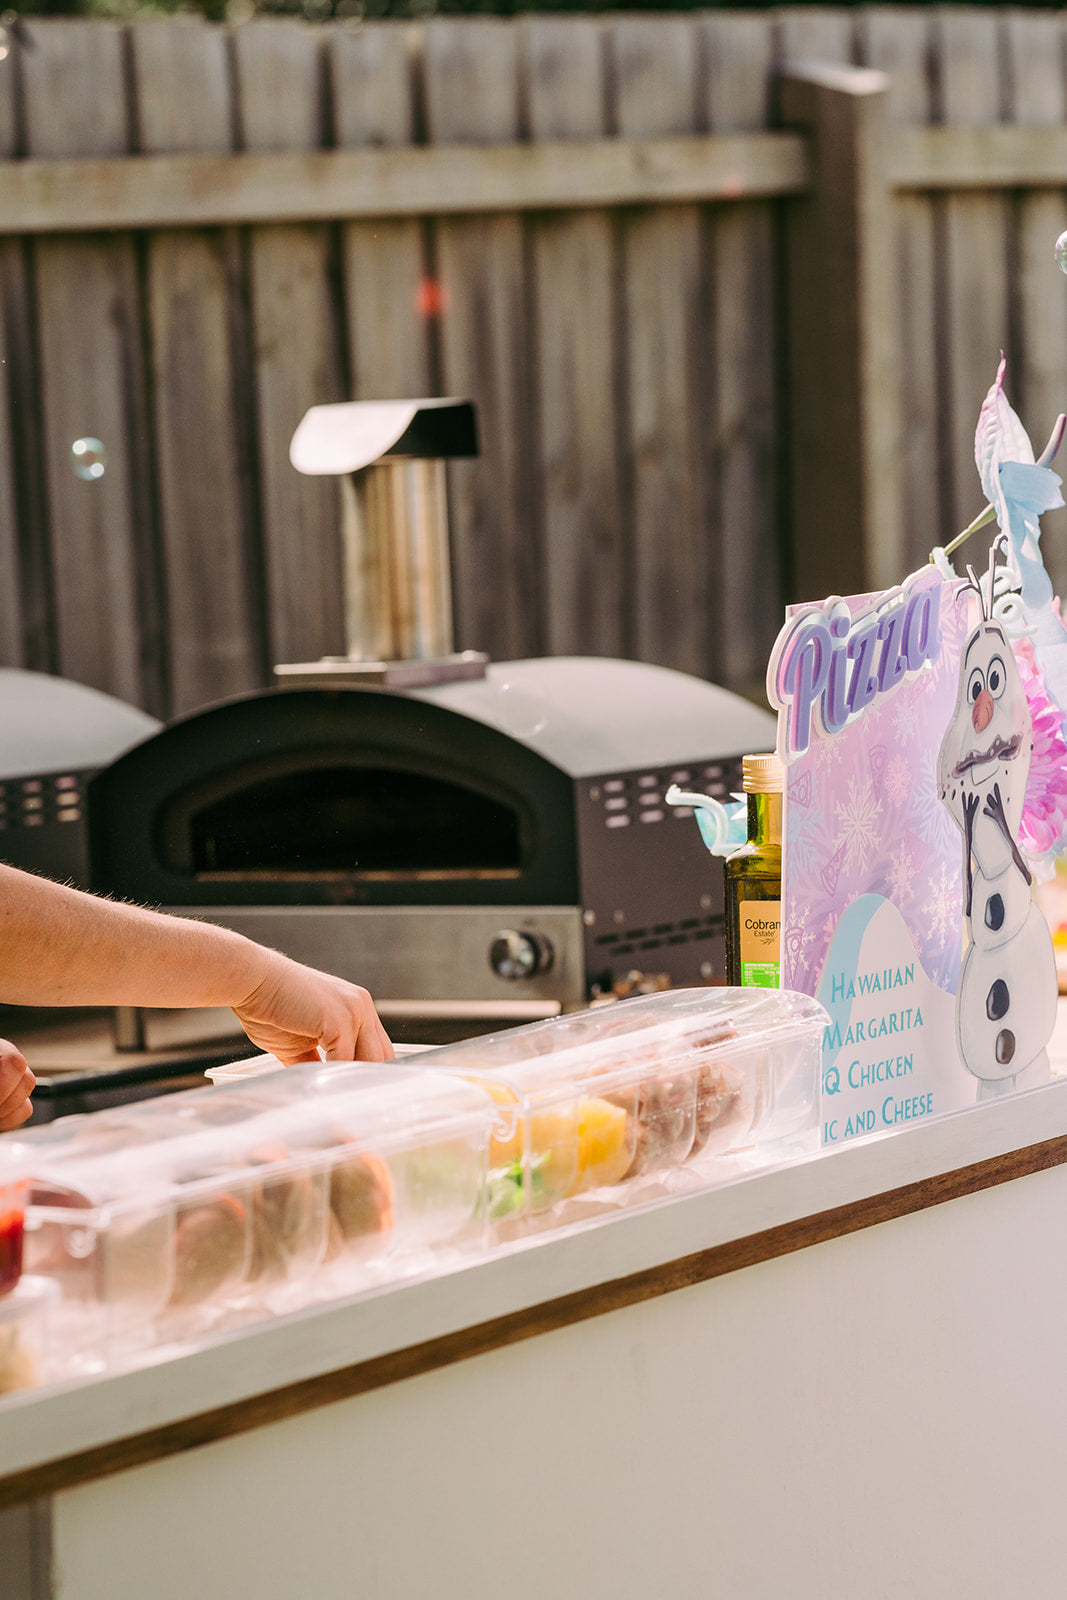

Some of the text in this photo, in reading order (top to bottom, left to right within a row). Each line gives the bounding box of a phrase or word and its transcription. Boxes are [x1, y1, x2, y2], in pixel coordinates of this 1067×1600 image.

[779, 582, 944, 752] Pizza
[848, 1053, 914, 1089] CHICKEN
[843, 1109, 876, 1137] AND
[881, 1092, 934, 1125] CHEESE
